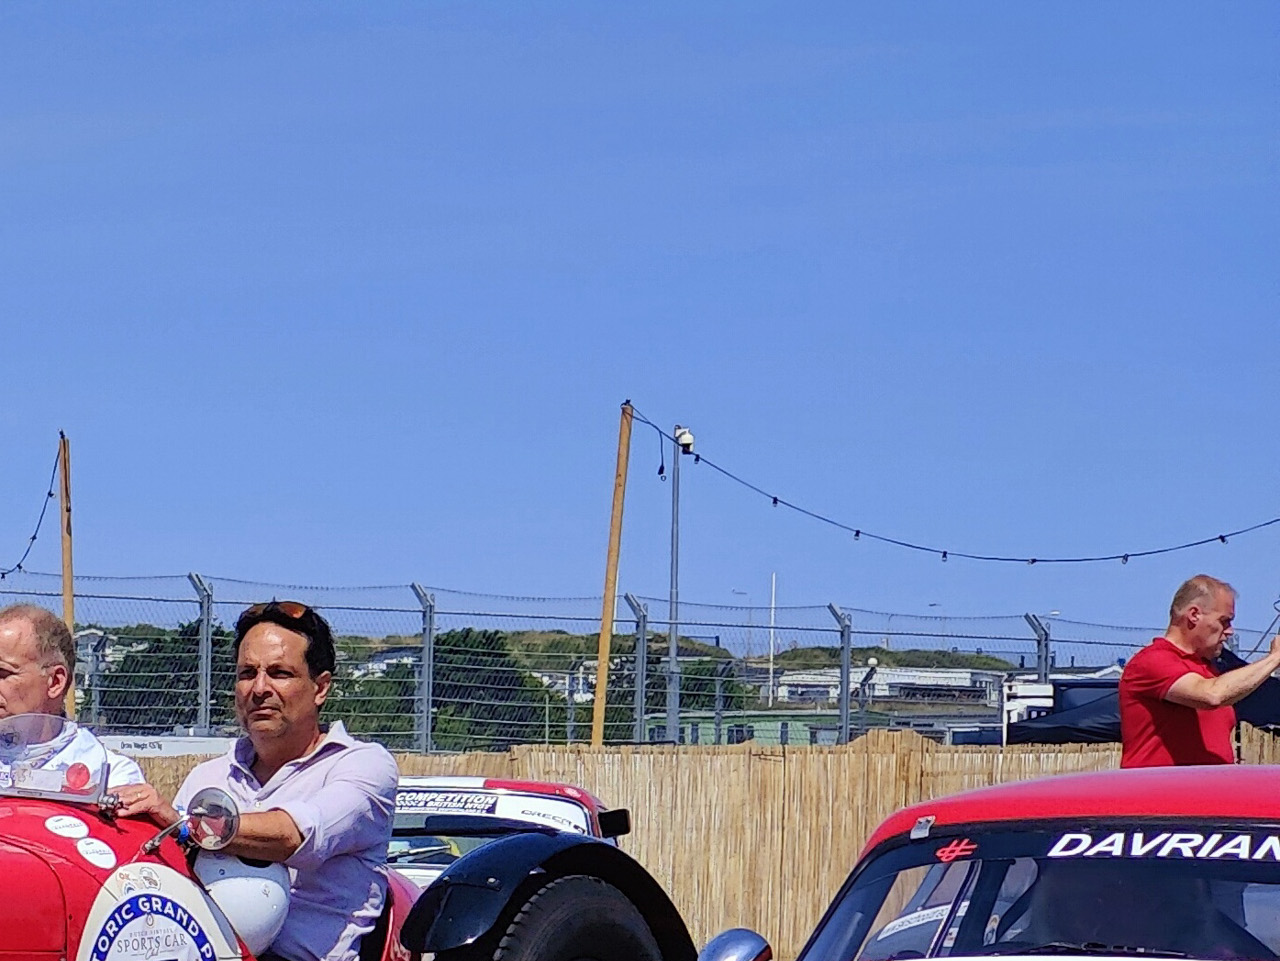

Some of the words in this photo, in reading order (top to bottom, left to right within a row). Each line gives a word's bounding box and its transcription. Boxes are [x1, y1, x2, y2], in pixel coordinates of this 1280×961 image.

[395, 791, 497, 805] COMPETITION
[138, 897, 200, 937] GRAND
[116, 936, 160, 953] SPORTS
[164, 933, 187, 947] CAR
